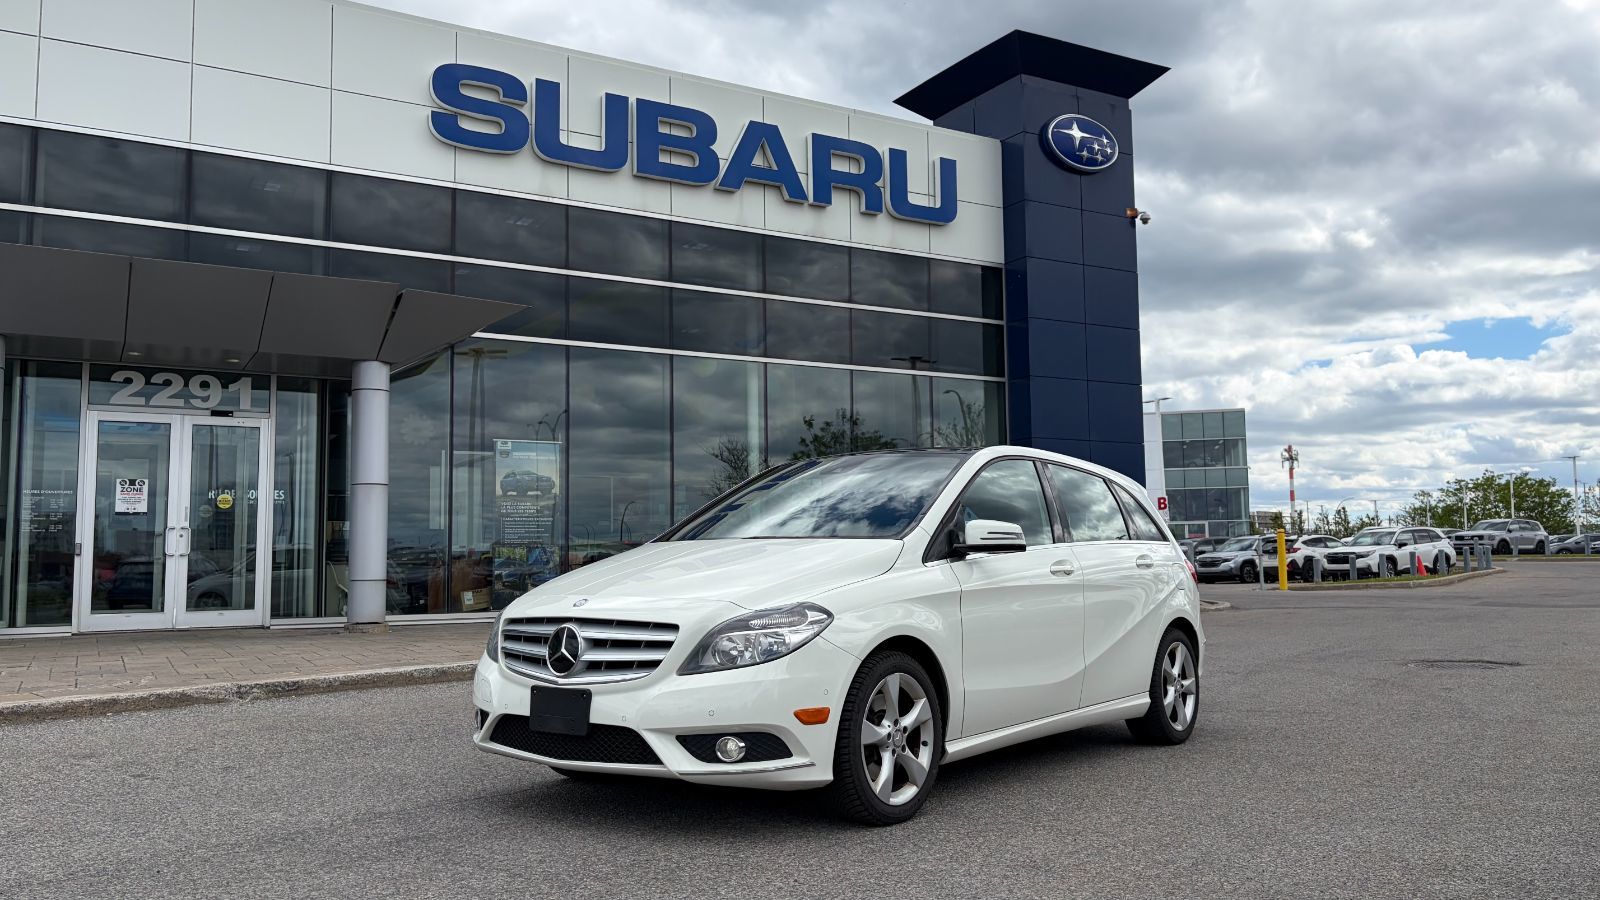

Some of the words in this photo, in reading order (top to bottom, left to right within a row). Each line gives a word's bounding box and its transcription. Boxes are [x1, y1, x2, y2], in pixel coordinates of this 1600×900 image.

[429, 62, 958, 226] SUBARU
[109, 370, 252, 409] 2291
[1157, 496, 1167, 511] B
